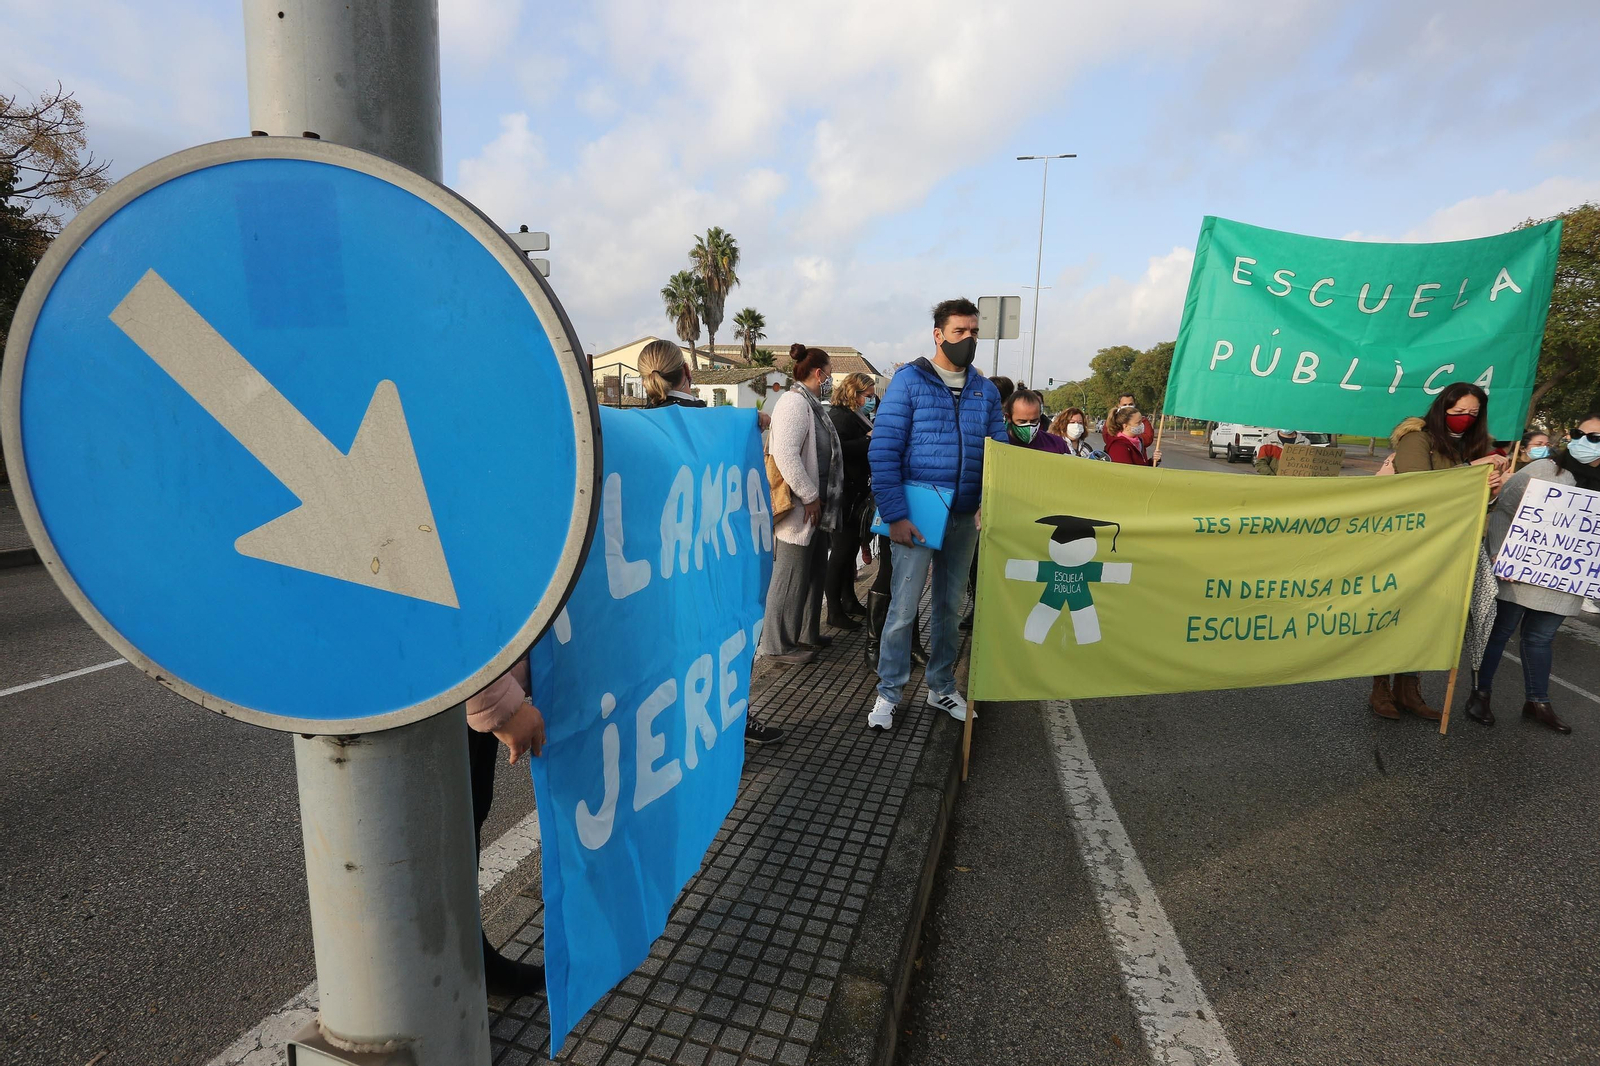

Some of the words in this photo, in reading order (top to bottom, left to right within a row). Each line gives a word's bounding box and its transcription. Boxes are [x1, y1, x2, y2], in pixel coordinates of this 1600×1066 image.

[1232, 255, 1522, 318] ESCUELA
[1209, 328, 1494, 396] PÚBLICA
[1286, 446, 1343, 459] DEFIENDAN
[1192, 517, 1231, 535] IES
[1238, 516, 1341, 535] FERNANDO
[1346, 512, 1426, 534] SAVATER
[1517, 505, 1545, 524] ES
[1552, 511, 1576, 529] UN
[1509, 524, 1548, 547] PARA
[553, 462, 771, 645] LAMPA
[1501, 542, 1586, 575] NUESTROS
[1055, 571, 1083, 582] ESCUELA
[1204, 579, 1232, 599] EN
[1240, 578, 1333, 600] DEFENSA
[1340, 576, 1363, 596] DE
[1372, 572, 1398, 593] LA
[1494, 560, 1514, 578] NO
[1518, 566, 1583, 594] PUEDEN
[1186, 614, 1298, 642] ESCUELA
[1306, 604, 1401, 636] PÚBLICA
